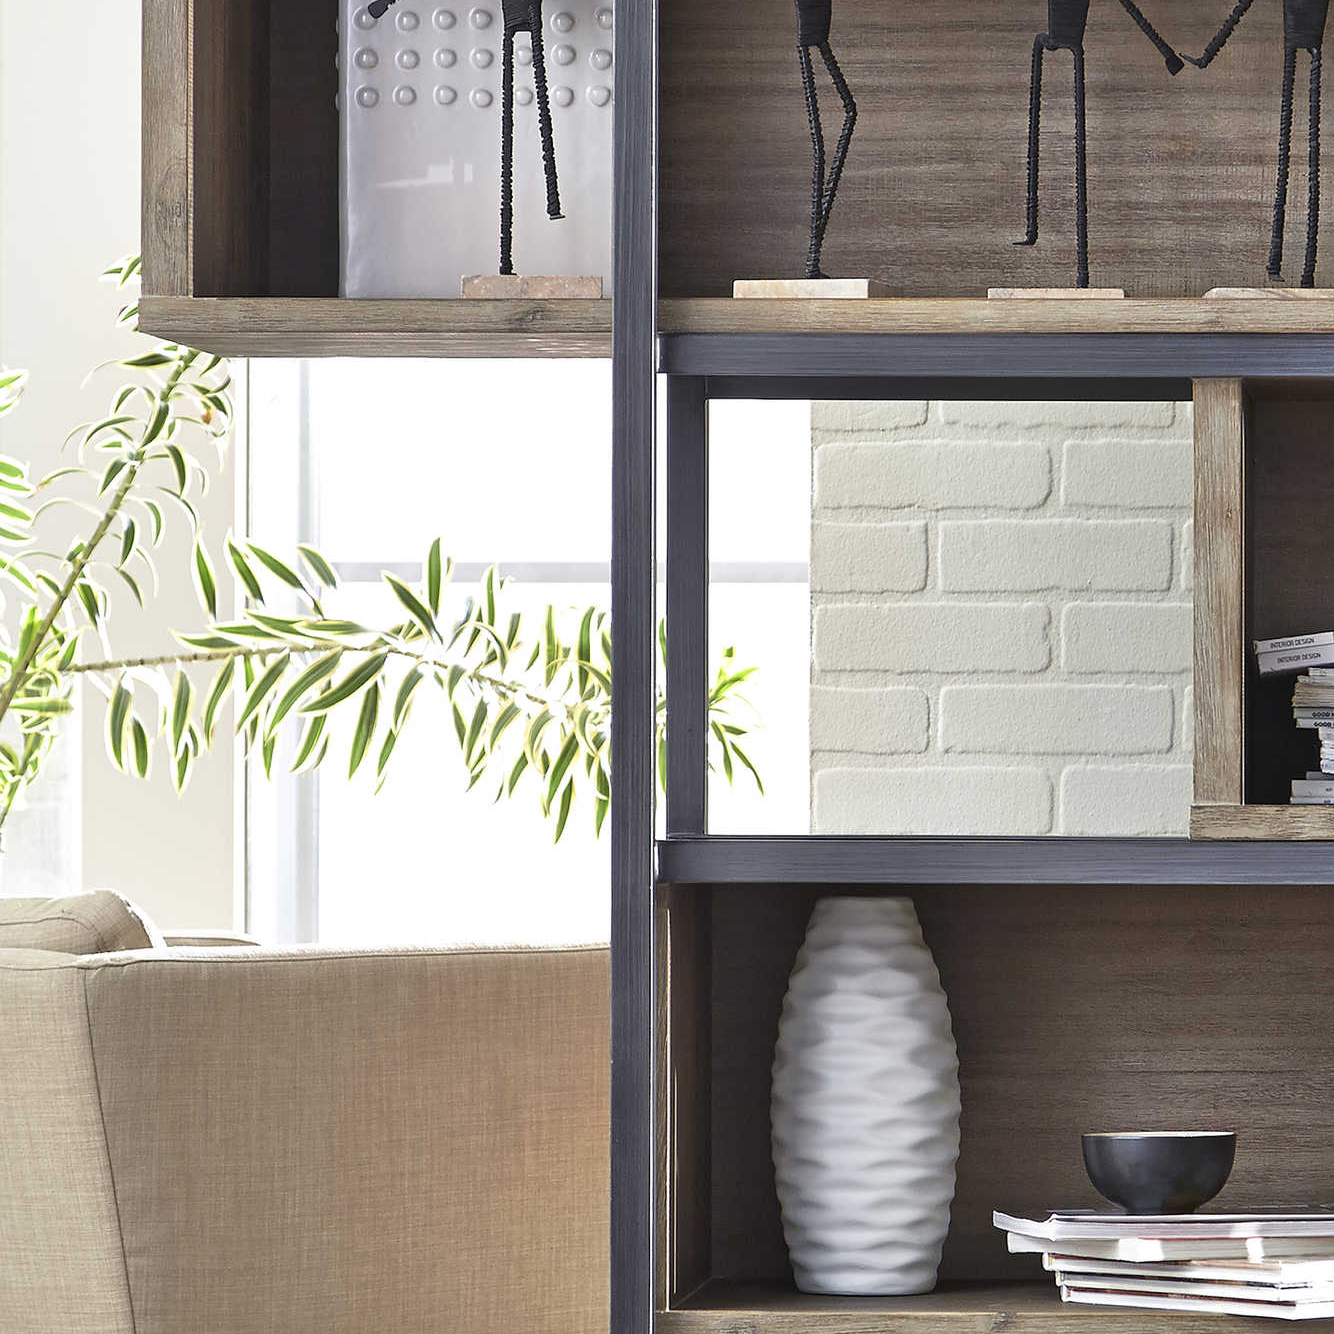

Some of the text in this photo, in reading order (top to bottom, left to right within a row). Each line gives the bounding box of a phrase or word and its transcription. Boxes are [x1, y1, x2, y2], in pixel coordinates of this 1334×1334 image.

[1270, 638, 1315, 649] INTERIOR DESIGN
[1277, 652, 1321, 664] INTERIOR DESIGN
